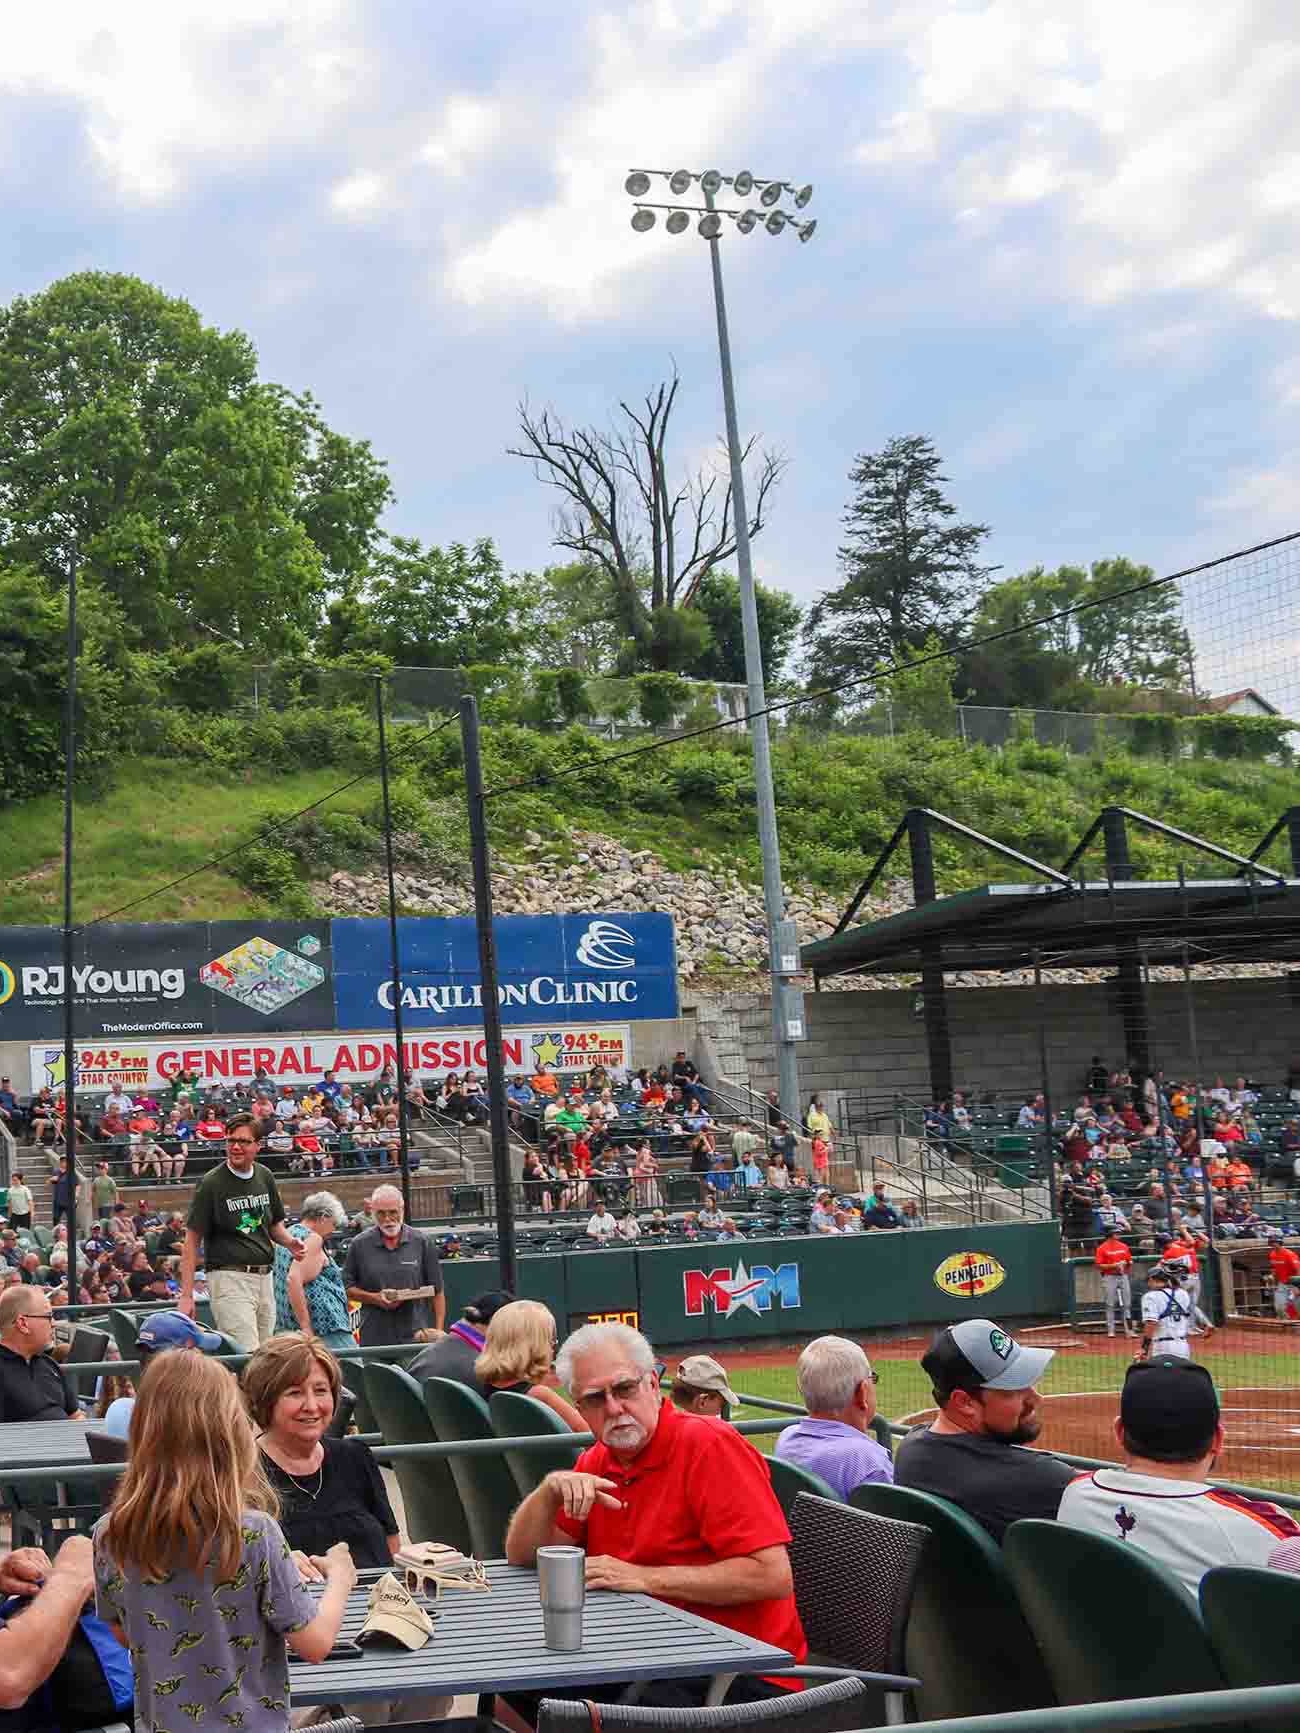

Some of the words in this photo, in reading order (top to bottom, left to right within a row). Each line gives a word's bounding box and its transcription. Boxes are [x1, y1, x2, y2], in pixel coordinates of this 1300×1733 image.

[21, 965, 66, 996] RJ
[71, 964, 185, 999] Young
[101, 1021, 203, 1032] TheModernOffice.com
[600, 1039, 623, 1051] FM
[120, 1057, 148, 1069] FM
[156, 1044, 323, 1080] GENERAL
[332, 1038, 522, 1073] ADMISSION
[564, 1055, 584, 1067] STAR
[81, 1072, 104, 1086] STAR
[107, 1071, 148, 1085] COUNTRY
[944, 1263, 994, 1285] PENNZOIL
